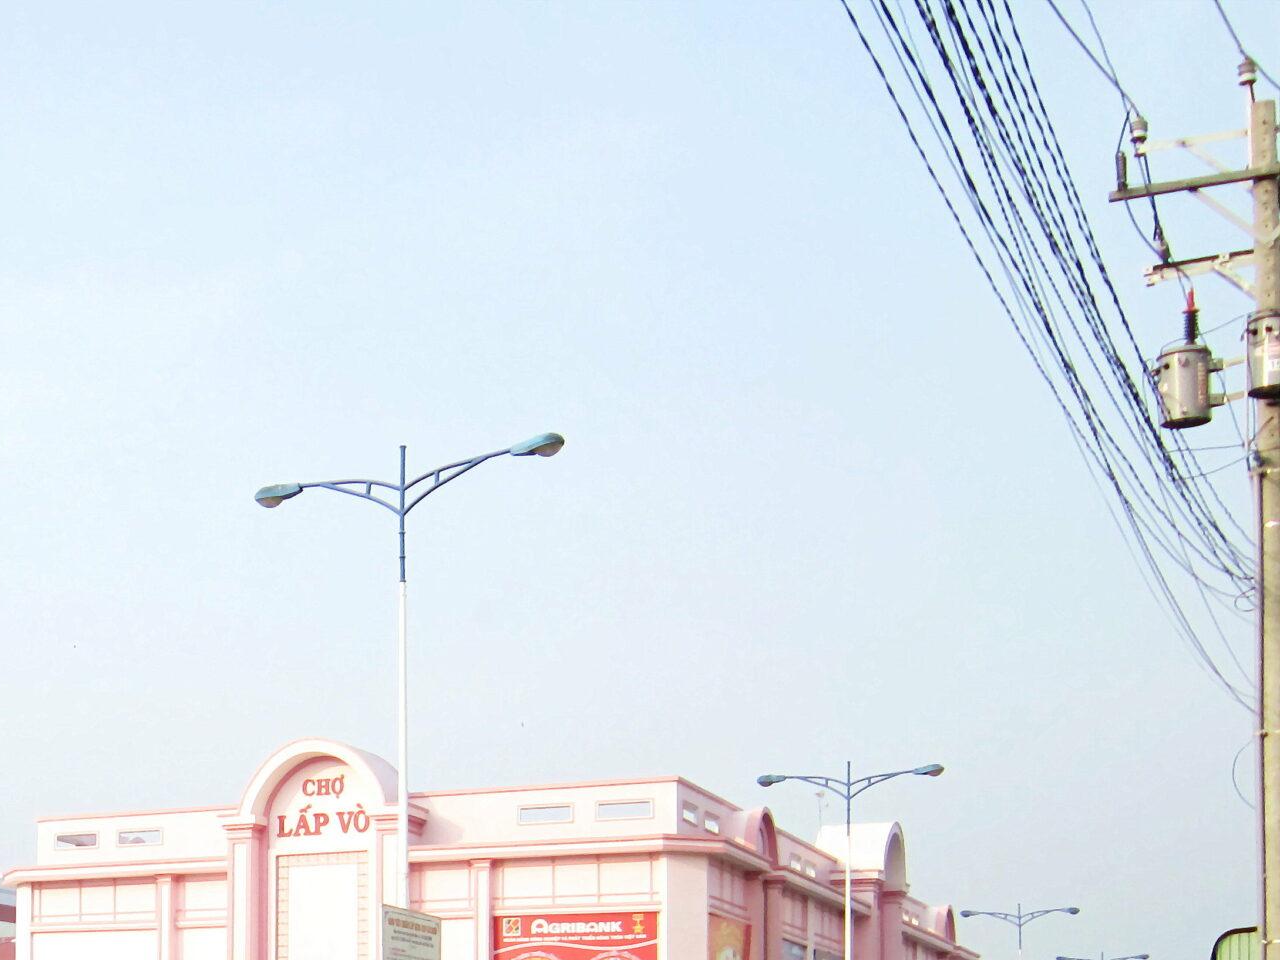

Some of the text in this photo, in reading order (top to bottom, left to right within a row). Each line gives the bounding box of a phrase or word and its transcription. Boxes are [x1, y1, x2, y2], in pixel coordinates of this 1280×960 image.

[302, 774, 344, 799] CHỢ
[277, 803, 370, 838] LẤP VÒ
